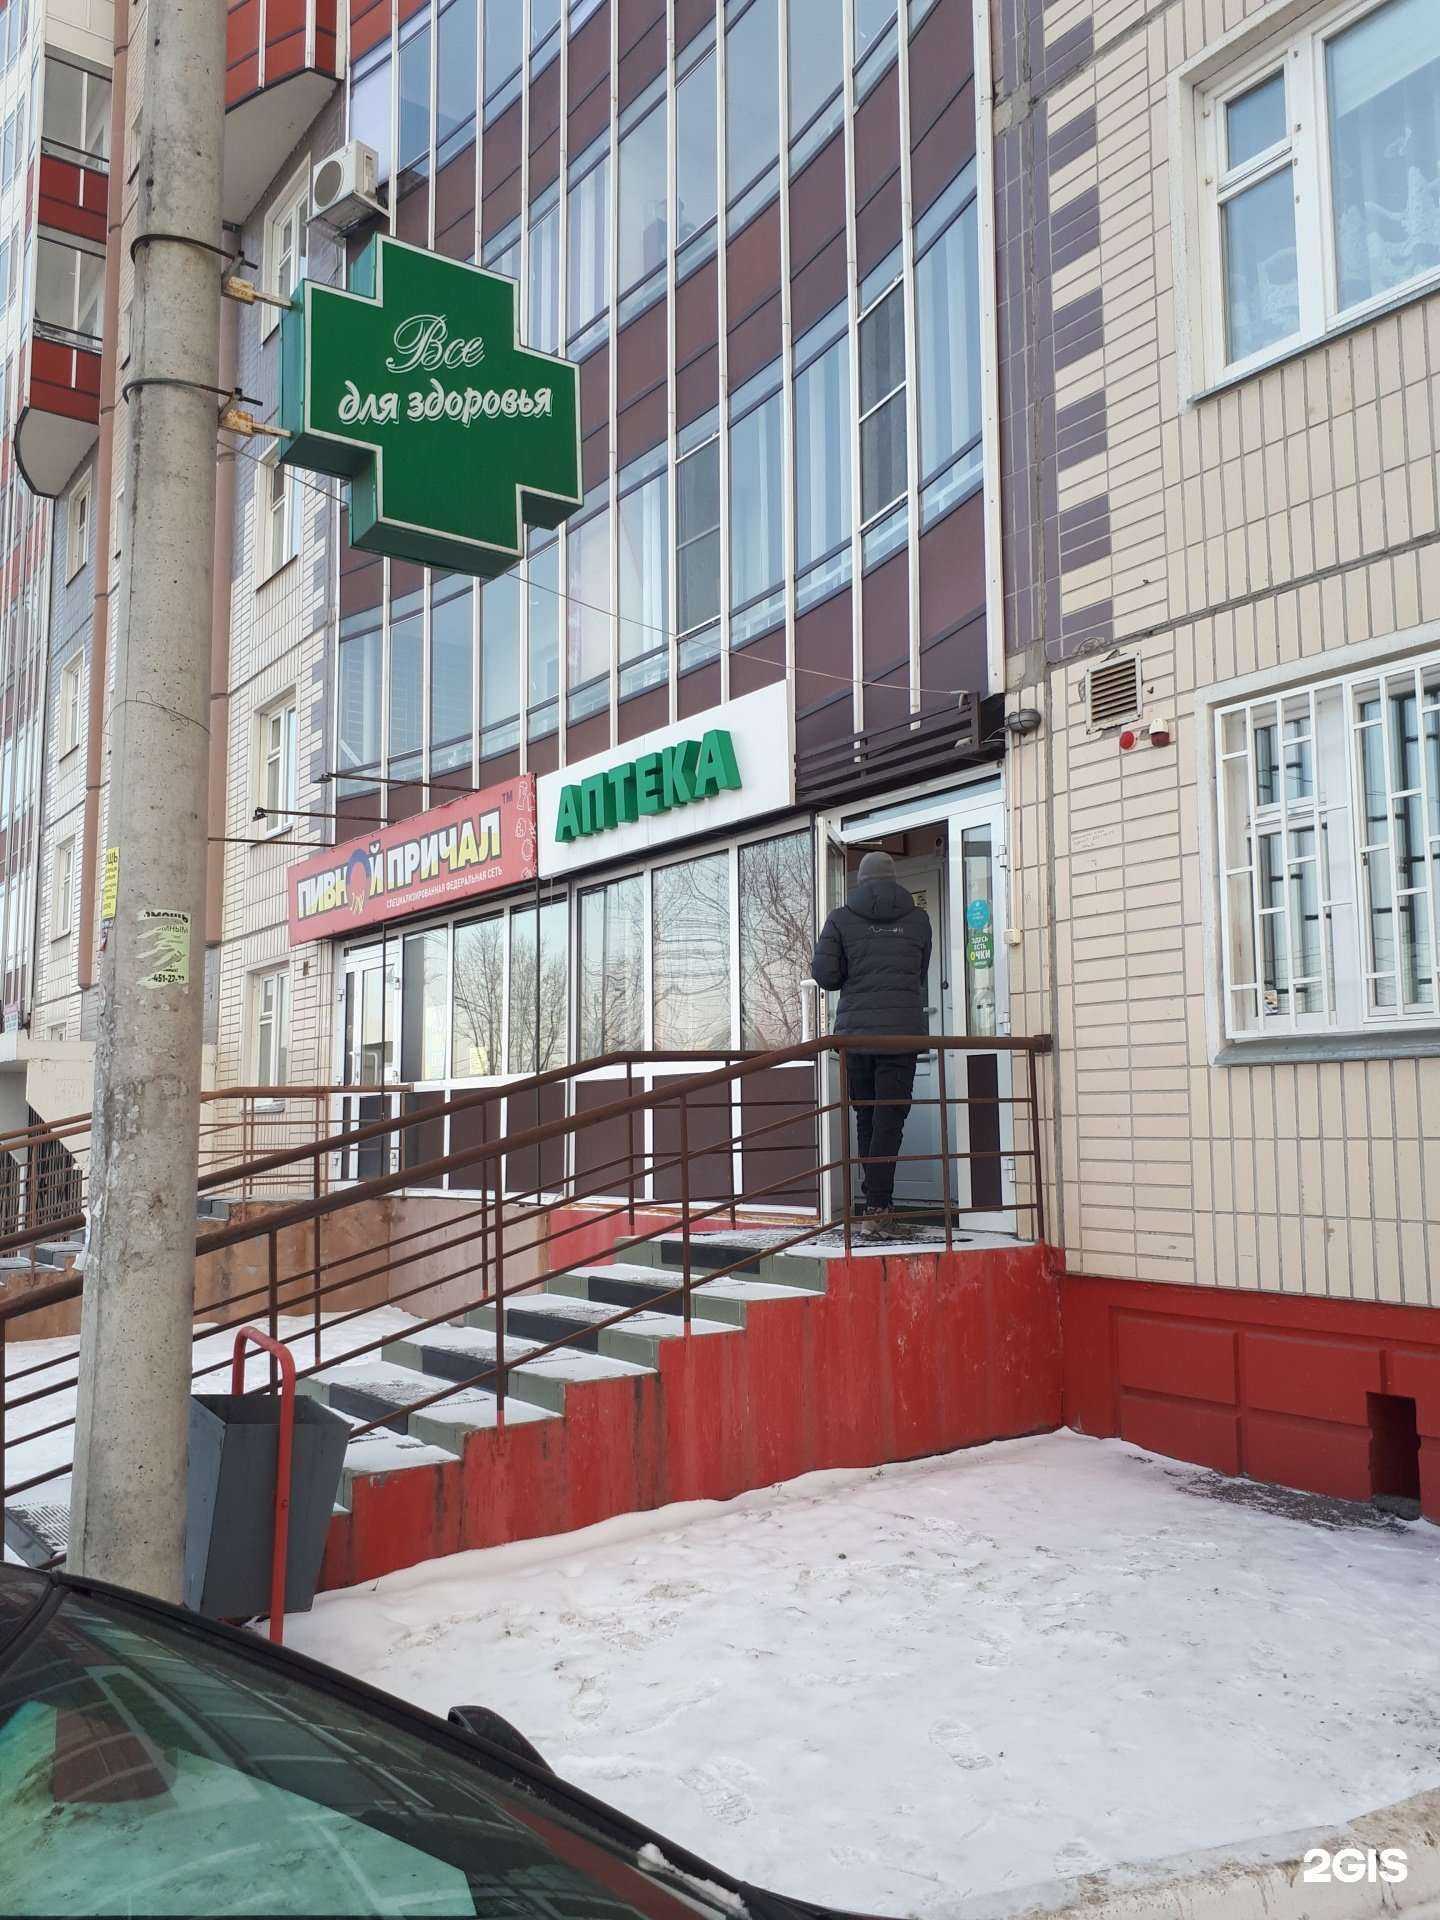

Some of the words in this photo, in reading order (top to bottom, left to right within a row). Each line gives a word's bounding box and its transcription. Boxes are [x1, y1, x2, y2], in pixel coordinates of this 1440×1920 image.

[386, 313, 485, 373] Все
[338, 379, 400, 425] для
[406, 378, 553, 427] здоровья
[555, 729, 743, 843] АПТЕКА
[387, 807, 502, 892] ПРИЧАЛ
[446, 871, 487, 890] ФЕДЕРАЛЬНАЯ
[487, 866, 504, 878] СЕТЬ
[970, 949, 991, 961] ОЧКИ
